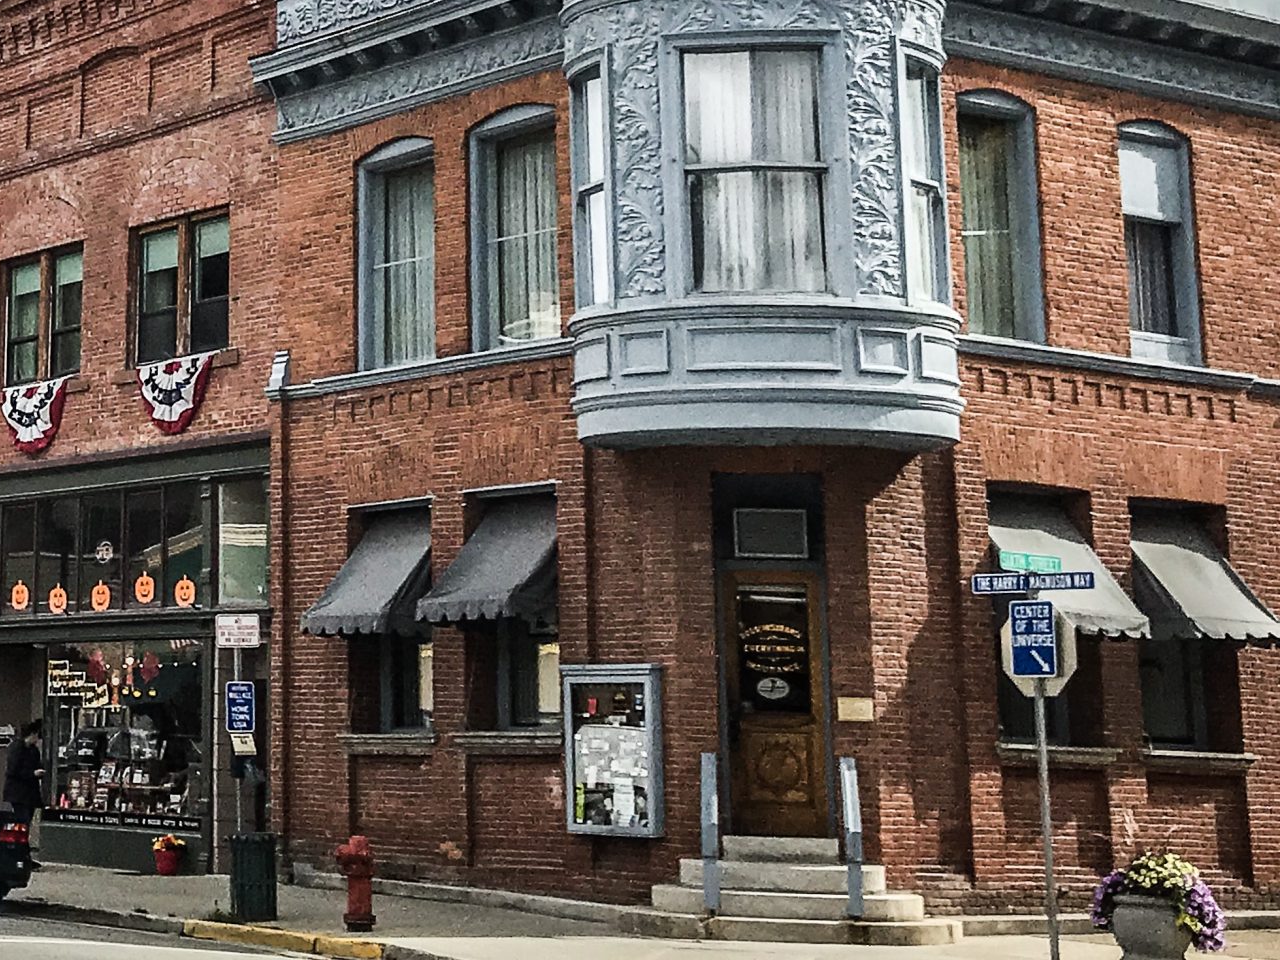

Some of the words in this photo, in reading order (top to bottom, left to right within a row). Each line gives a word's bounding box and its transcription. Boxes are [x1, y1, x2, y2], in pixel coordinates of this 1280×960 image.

[977, 577, 991, 590] THE
[993, 577, 1017, 590] HARRY
[1029, 575, 1071, 589] MAGNUSON
[1074, 574, 1090, 587] WAY
[1014, 605, 1050, 618] CENTER
[1015, 620, 1028, 632] OF
[1032, 620, 1050, 632] THE
[1013, 634, 1054, 647] UNIVERSE
